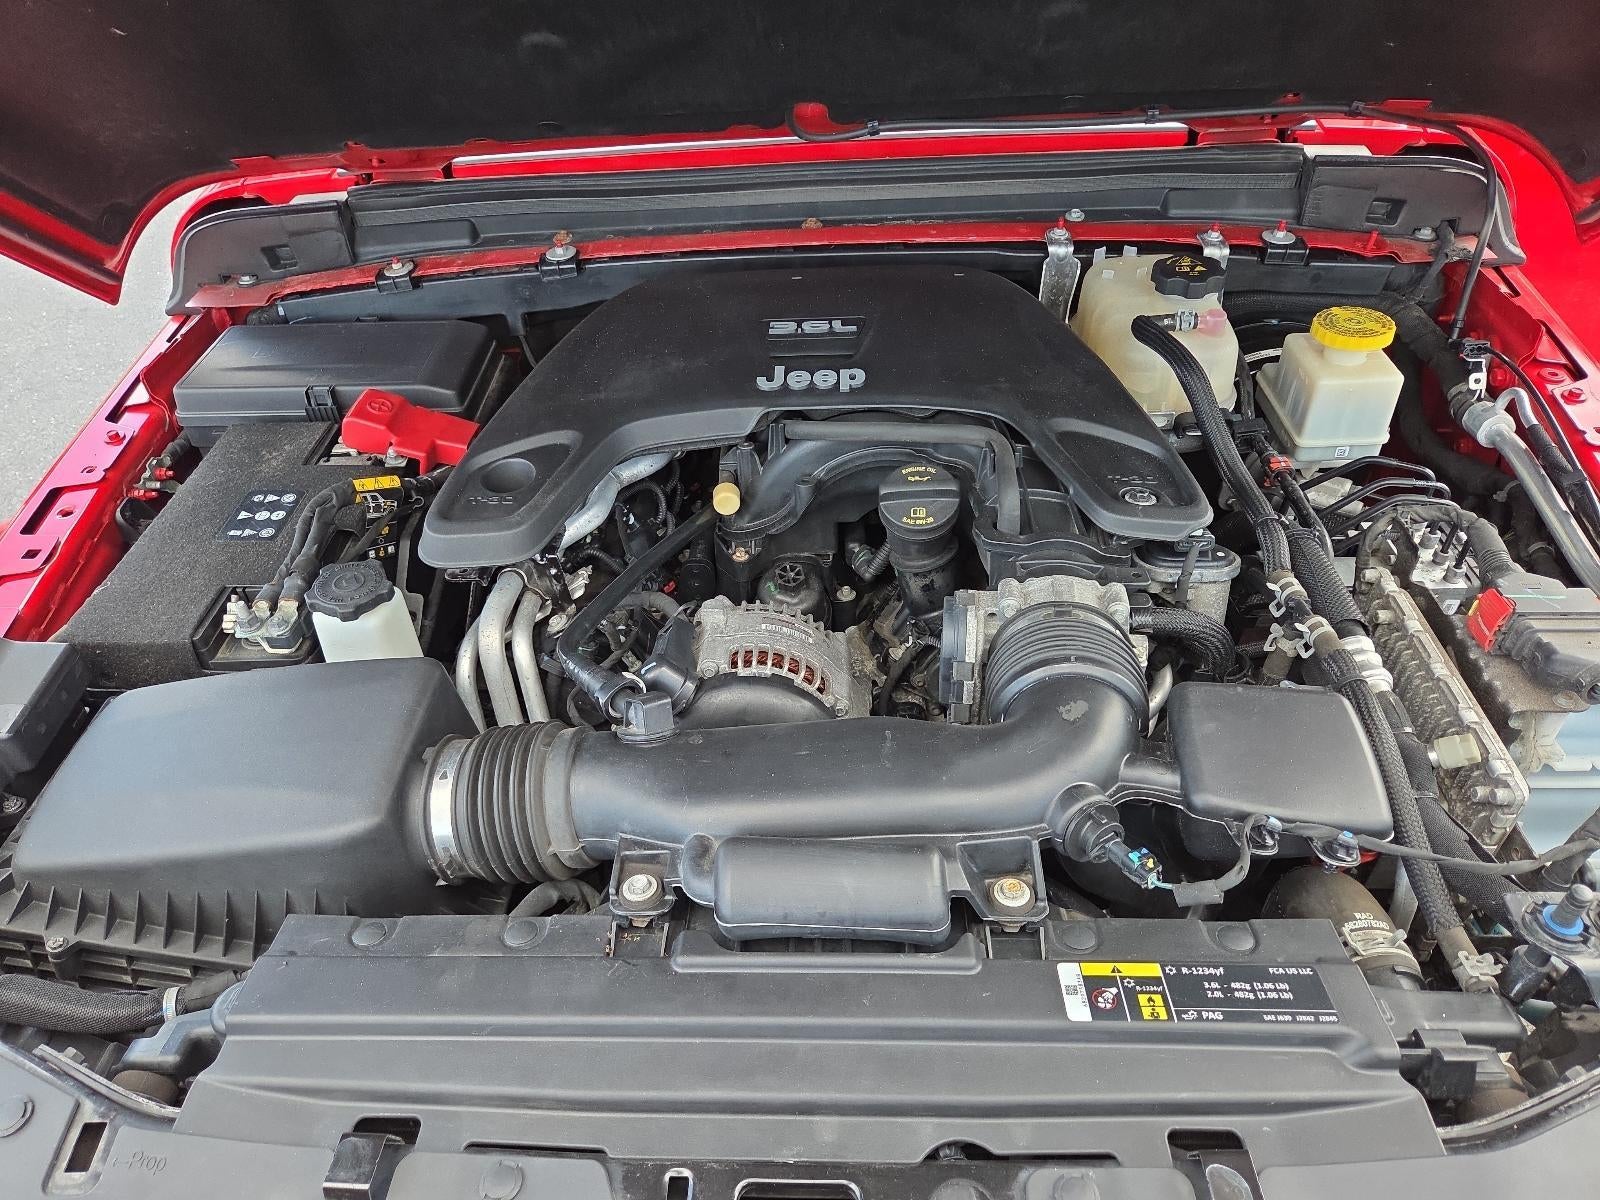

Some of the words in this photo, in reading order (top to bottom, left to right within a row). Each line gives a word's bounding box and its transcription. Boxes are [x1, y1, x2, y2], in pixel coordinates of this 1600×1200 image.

[768, 320, 858, 335] 3.6L
[756, 365, 866, 393] Jeep
[901, 466, 926, 475] ENGINE
[902, 516, 915, 525] SAE
[915, 516, 935, 525] 0W-20
[1353, 912, 1374, 920] RAD
[1181, 967, 1224, 976] R-1234yf
[1268, 967, 1285, 975] FCA
[1285, 967, 1298, 975] US
[1297, 967, 1314, 975] LLC
[1203, 981, 1221, 989] 3.6L
[1230, 982, 1251, 990] 482g
[1253, 982, 1275, 990] (1.06
[1275, 982, 1290, 991] Lb)
[1206, 990, 1224, 998] 2.0L
[1234, 991, 1255, 999] 482g
[1256, 991, 1279, 1000] (1.06
[1278, 991, 1293, 1000] Lb)
[1201, 1010, 1224, 1020] PAG
